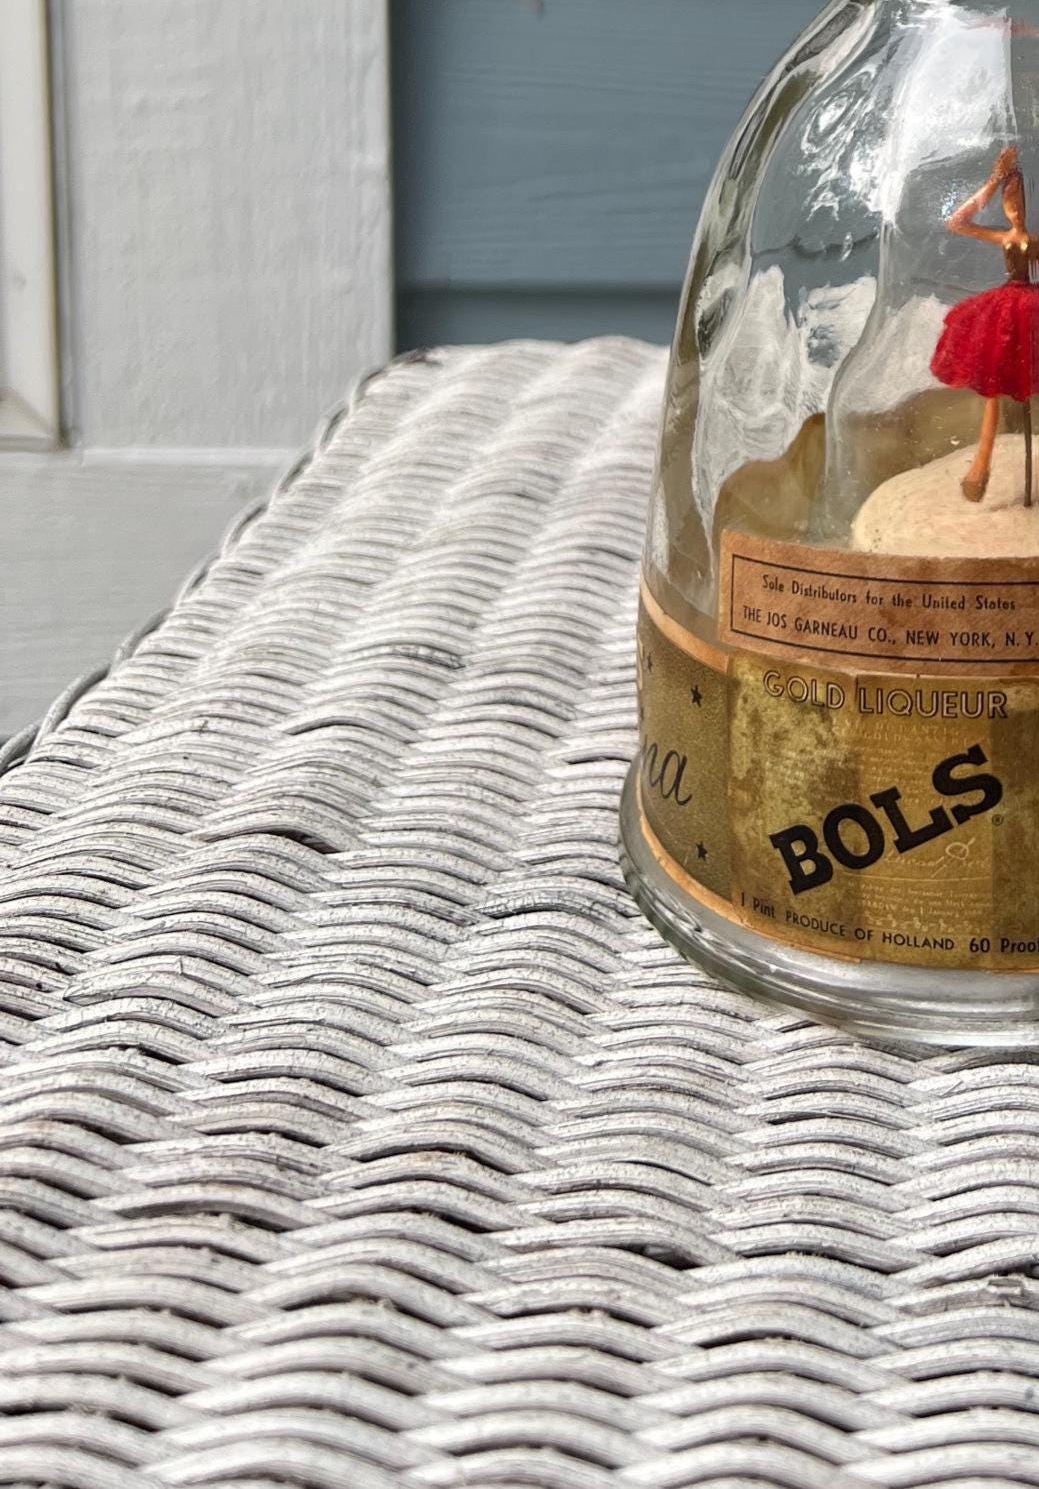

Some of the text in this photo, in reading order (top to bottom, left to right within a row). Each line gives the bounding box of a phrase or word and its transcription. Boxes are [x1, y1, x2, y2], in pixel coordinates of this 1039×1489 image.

[762, 574, 1016, 611] Sole Distributors for the United States
[743, 605, 762, 623] THE
[766, 611, 788, 629] JOS
[794, 617, 858, 640] GARNEAU
[868, 626, 896, 646] CO.,
[906, 630, 940, 646] NEW
[950, 631, 996, 649] YORK,
[763, 669, 1009, 719] GOLD LIQUEUR
[768, 743, 1004, 896] BOLS
[752, 896, 777, 919] Pint
[785, 910, 847, 937] PRODUCE
[854, 927, 875, 942] OF
[882, 932, 955, 951] HOLLAND
[969, 937, 991, 953] 60
